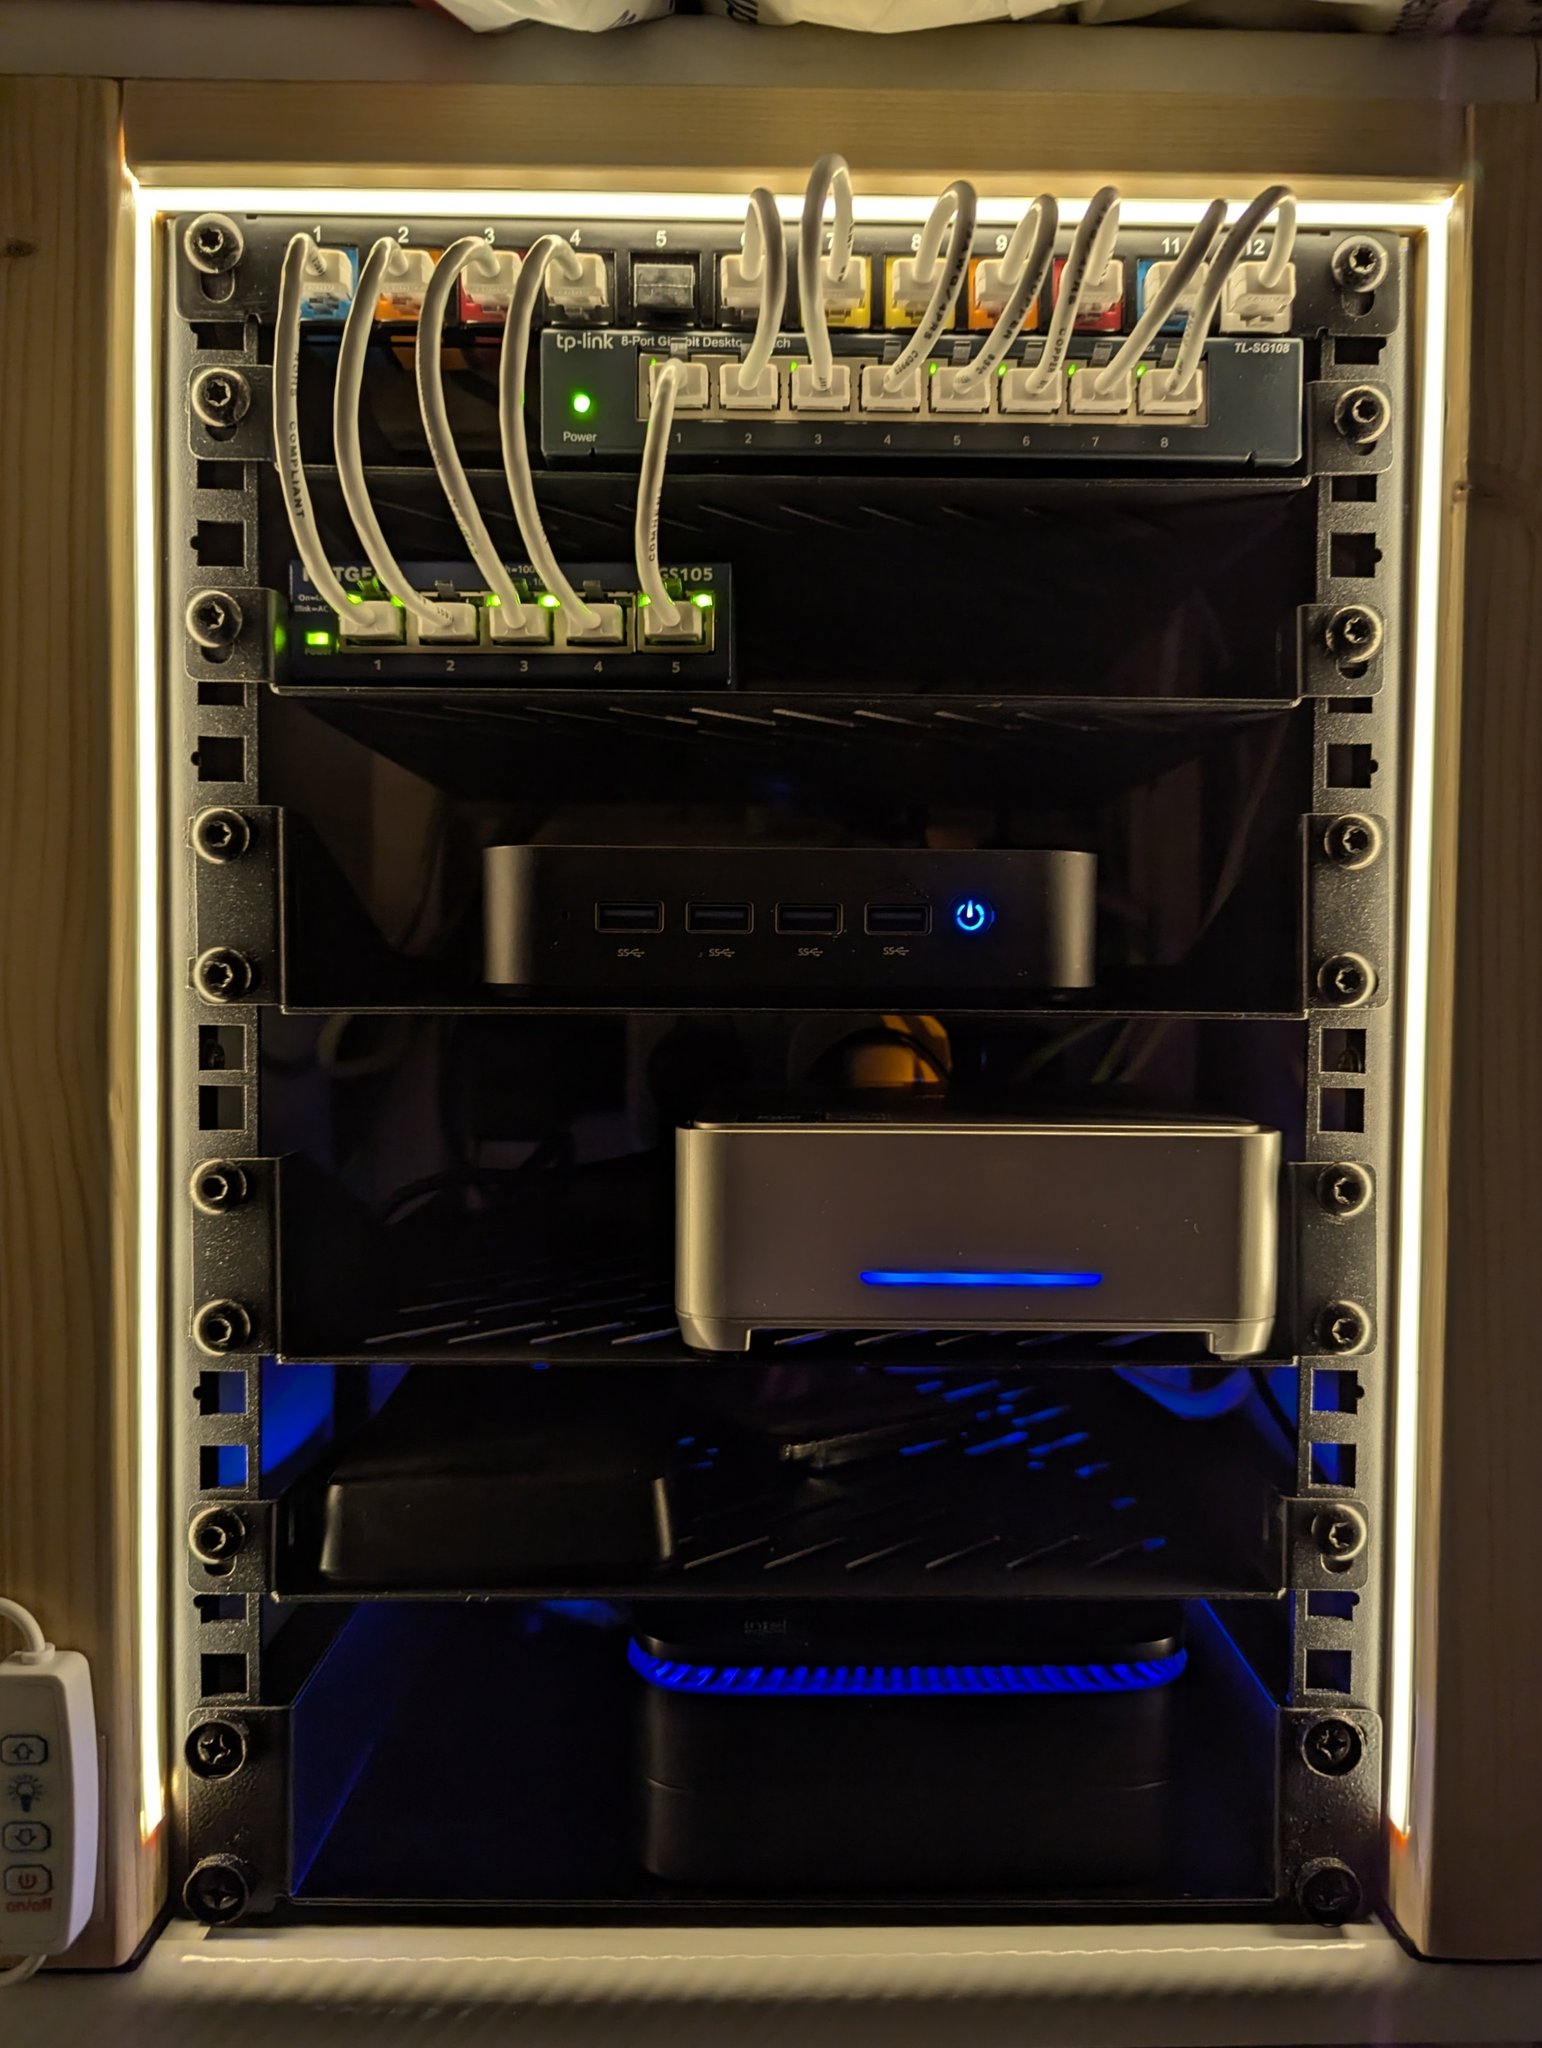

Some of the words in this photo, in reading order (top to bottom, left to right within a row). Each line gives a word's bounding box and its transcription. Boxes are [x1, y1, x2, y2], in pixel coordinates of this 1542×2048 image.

[312, 225, 321, 243] 1
[397, 226, 409, 243] 2
[484, 227, 495, 244] 3
[569, 229, 581, 246] 4
[656, 230, 667, 247] 5
[911, 233, 922, 251] 8
[995, 235, 1008, 252] 9
[1161, 237, 1180, 254] 11
[1246, 238, 1265, 255] 12
[556, 331, 614, 353] tp-link
[621, 335, 655, 347] 8-Port
[657, 336, 700, 348] Gibit
[702, 336, 742, 348] Deskto
[1234, 342, 1291, 354] TL-SG108
[562, 431, 598, 443] Power
[676, 433, 682, 443] 1
[745, 433, 753, 444] 2
[814, 434, 822, 445] 3
[883, 434, 892, 445] 4
[953, 435, 961, 446] 5
[1022, 436, 1031, 447] 6
[1091, 436, 1100, 447] 7
[1160, 436, 1169, 448] 8
[288, 421, 304, 518] COMPLIANT
[659, 567, 713, 581] GS105
[373, 659, 382, 671] 1
[446, 659, 455, 671] 2
[519, 660, 529, 672] 3
[593, 661, 603, 672] 4
[671, 661, 681, 673] 5
